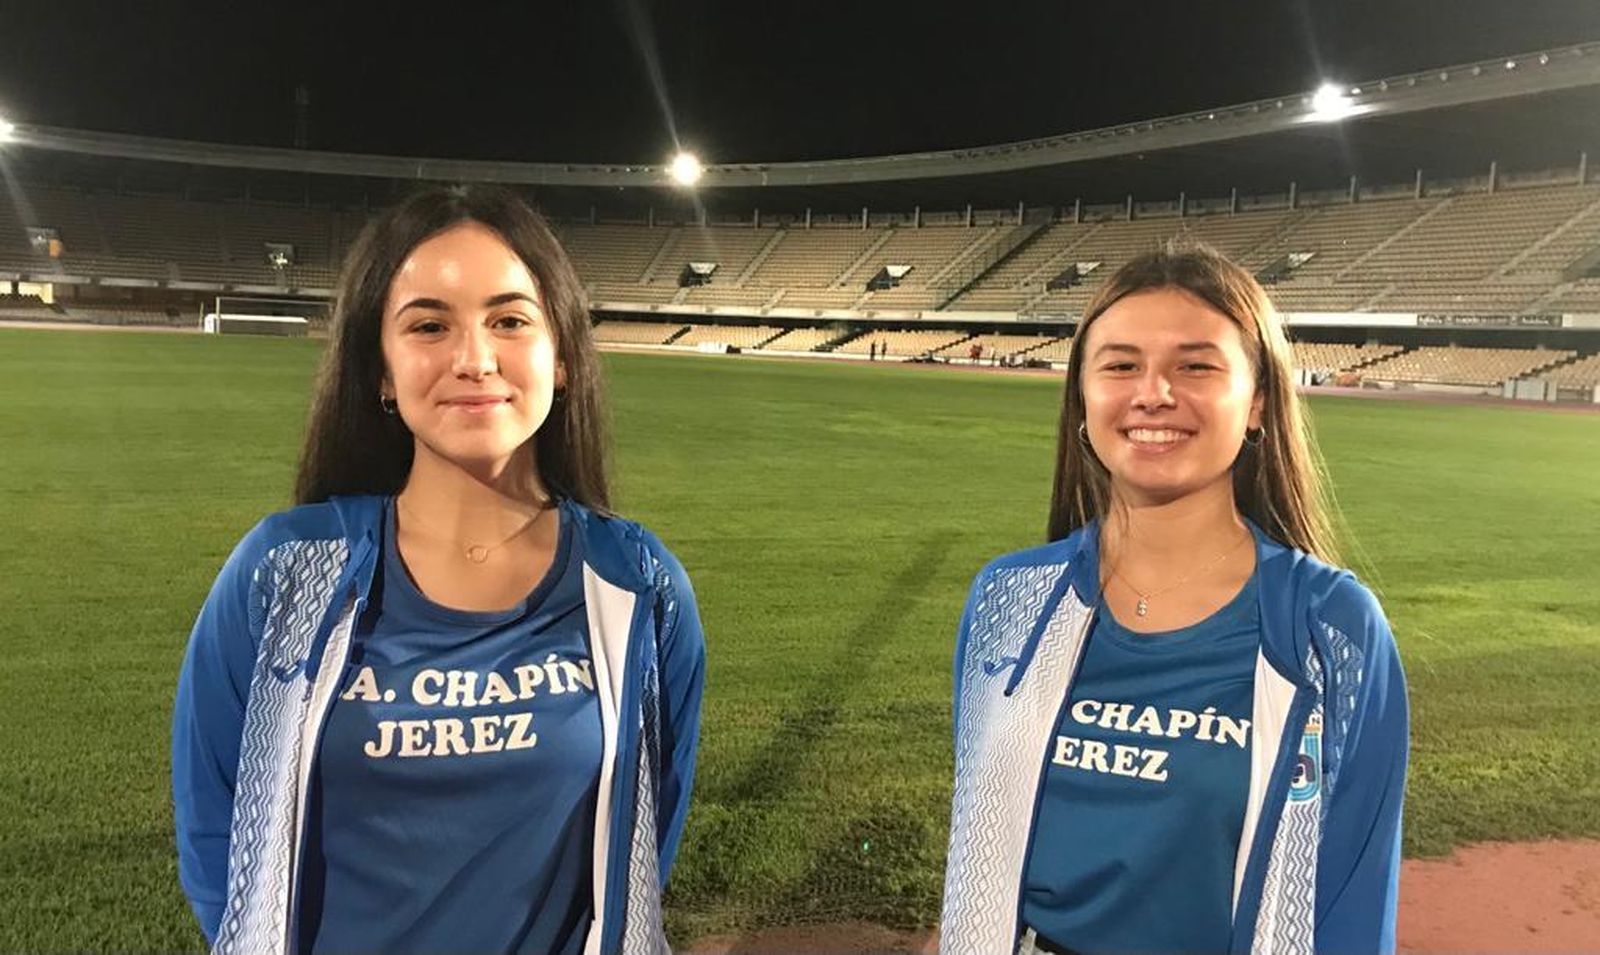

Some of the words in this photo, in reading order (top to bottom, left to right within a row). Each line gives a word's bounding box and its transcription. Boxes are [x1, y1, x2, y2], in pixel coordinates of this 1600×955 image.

[342, 666, 396, 702] A.
[412, 653, 594, 707] CHAPÍN
[364, 712, 537, 757] JEREZ
[1071, 700, 1251, 748] CHAPÍN
[1052, 735, 1169, 782] EREZ
